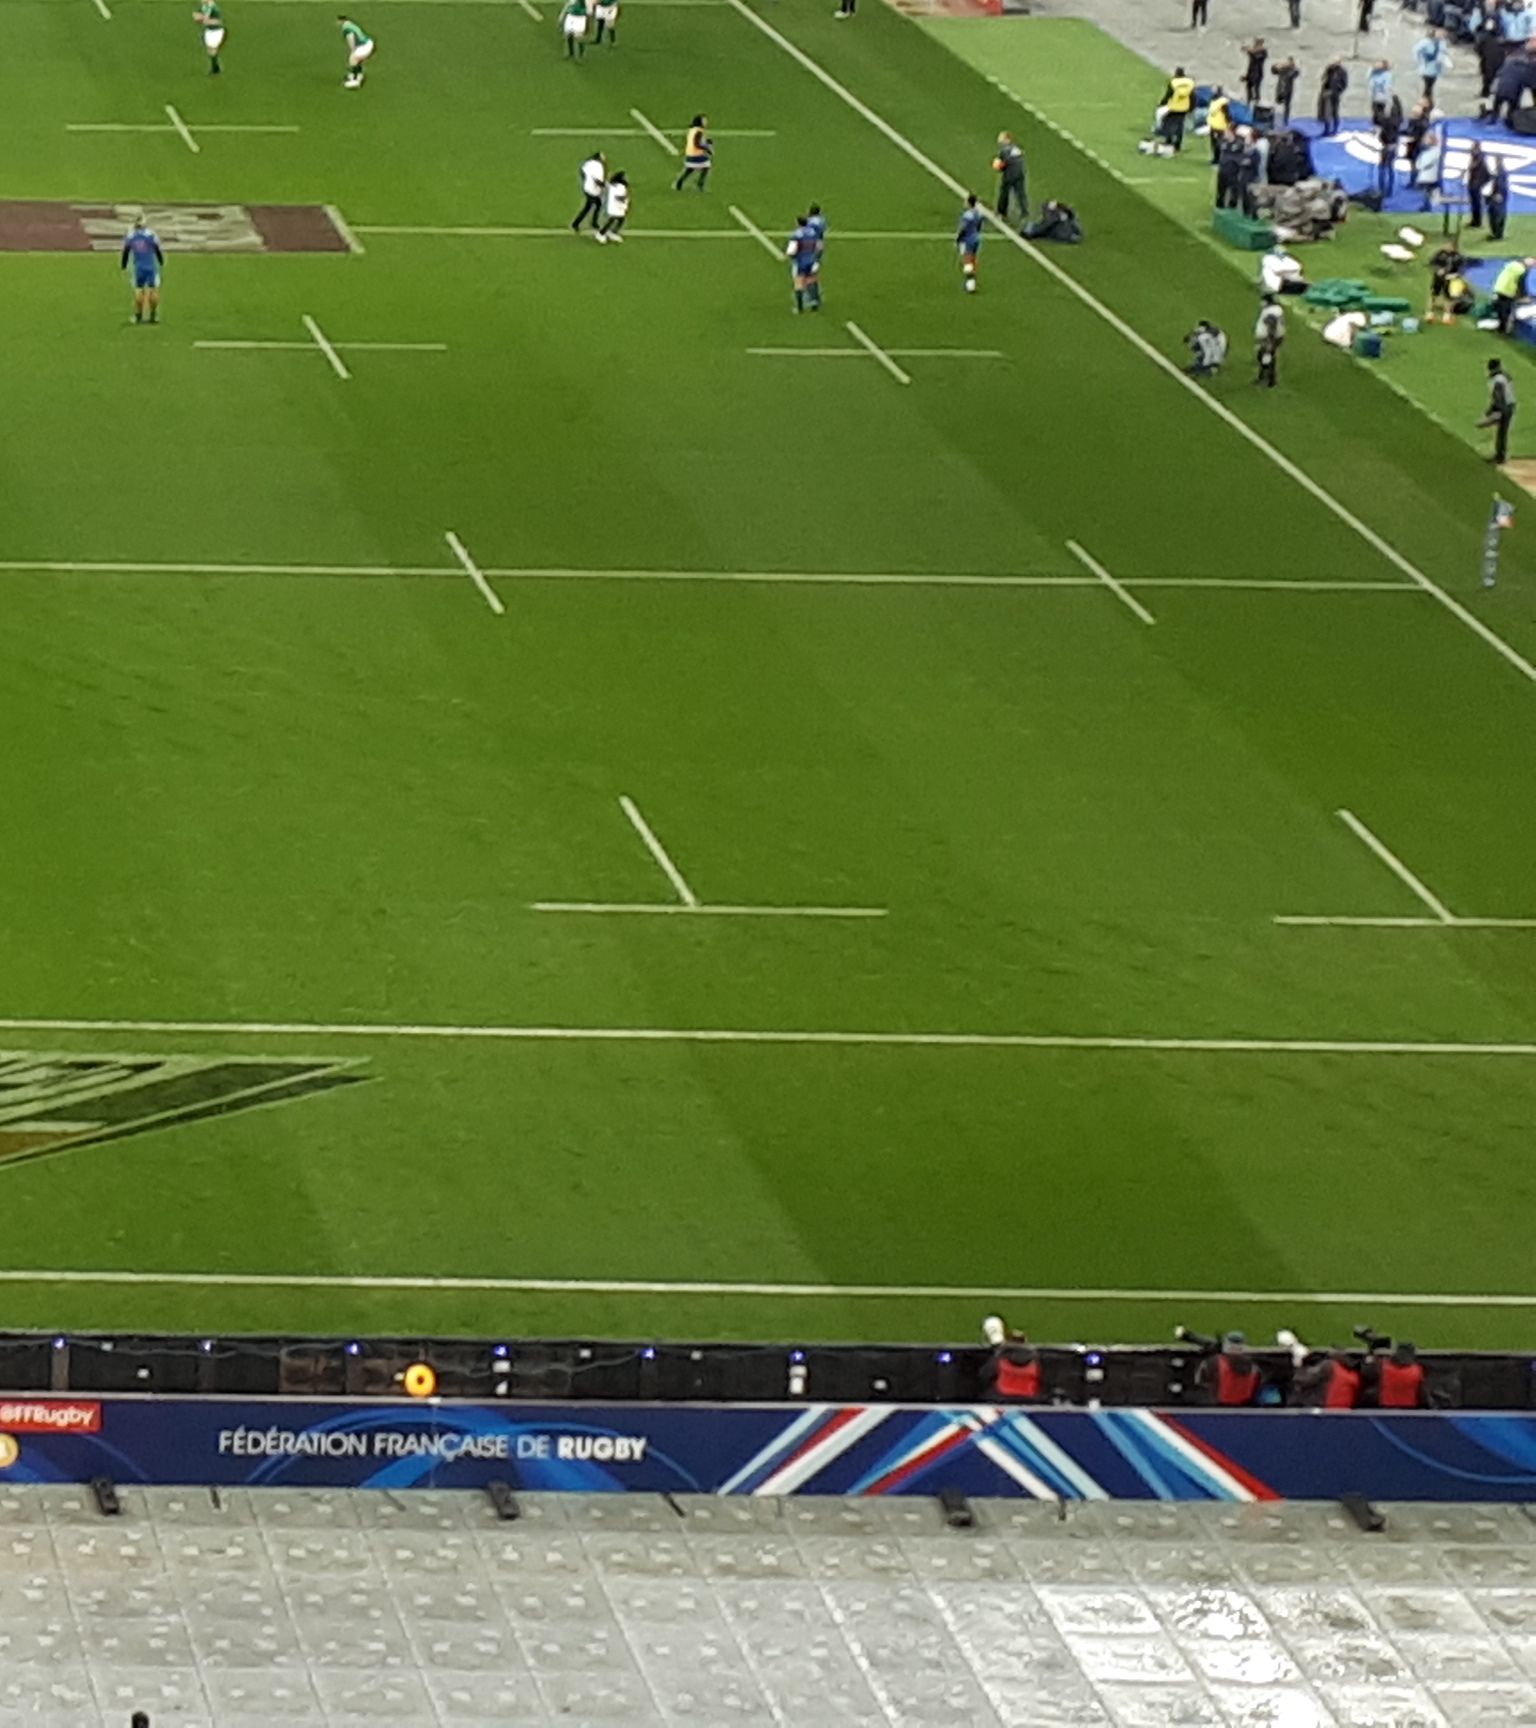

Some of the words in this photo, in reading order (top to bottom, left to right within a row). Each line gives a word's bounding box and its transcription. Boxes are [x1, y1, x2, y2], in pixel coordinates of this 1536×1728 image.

[218, 1425, 370, 1457] FÉDÉRATION
[373, 1432, 509, 1463] FRANÇAISE
[516, 1434, 550, 1460] DE
[556, 1435, 648, 1462] RUGBY
